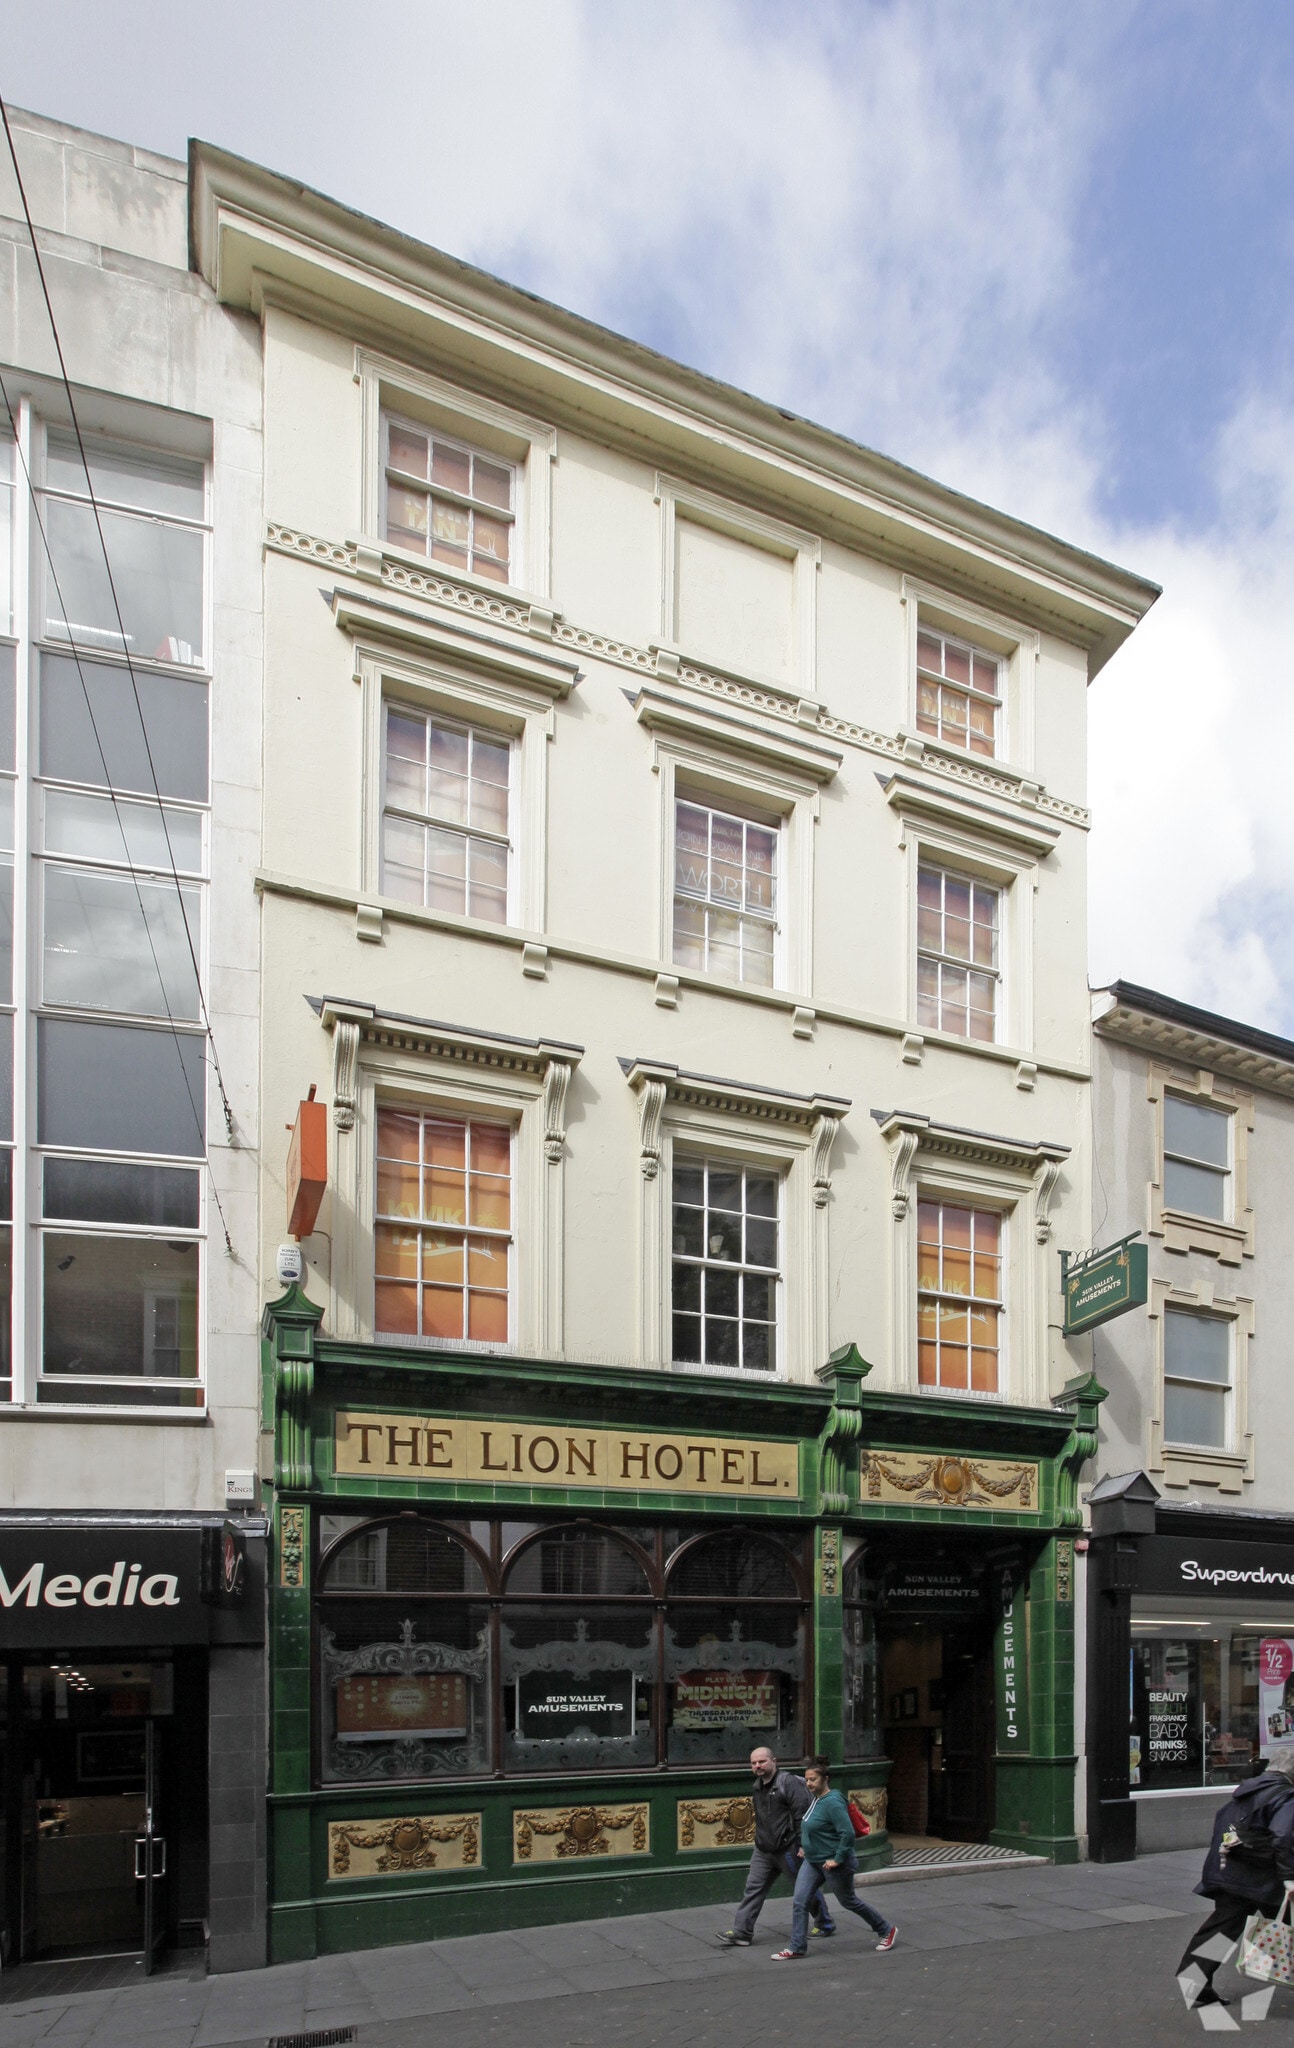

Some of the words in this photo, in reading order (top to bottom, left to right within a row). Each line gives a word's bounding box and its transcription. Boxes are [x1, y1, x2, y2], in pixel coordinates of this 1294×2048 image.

[679, 863, 762, 903] WORTH
[1081, 1287, 1094, 1296] SUN
[1094, 1275, 1114, 1290] VALLEY
[1075, 1279, 1121, 1307] AMUSEMENTS
[347, 1423, 453, 1468] THE
[480, 1432, 597, 1476] LION
[620, 1441, 790, 1488] HOTEL.
[227, 1485, 253, 1494] KINGS
[905, 1575, 925, 1583] SUN
[927, 1576, 962, 1584] VALLEY
[1180, 1560, 1294, 1586] Superdru
[0, 1561, 180, 1607] Media
[888, 1588, 980, 1597] AMUSEMENTS
[1001, 1569, 1018, 1738] AMUSEMENTS
[546, 1695, 567, 1703] SUN
[676, 1685, 774, 1701] MIDNIGHT
[1149, 1692, 1187, 1702] BEAUTY
[528, 1703, 624, 1713] AMUSEMENTS
[1149, 1702, 1187, 1714] HEALTH
[1149, 1714, 1187, 1722] FRAGRANCE
[1149, 1723, 1187, 1738] BABY
[1149, 1750, 1187, 1761] SNACKS
